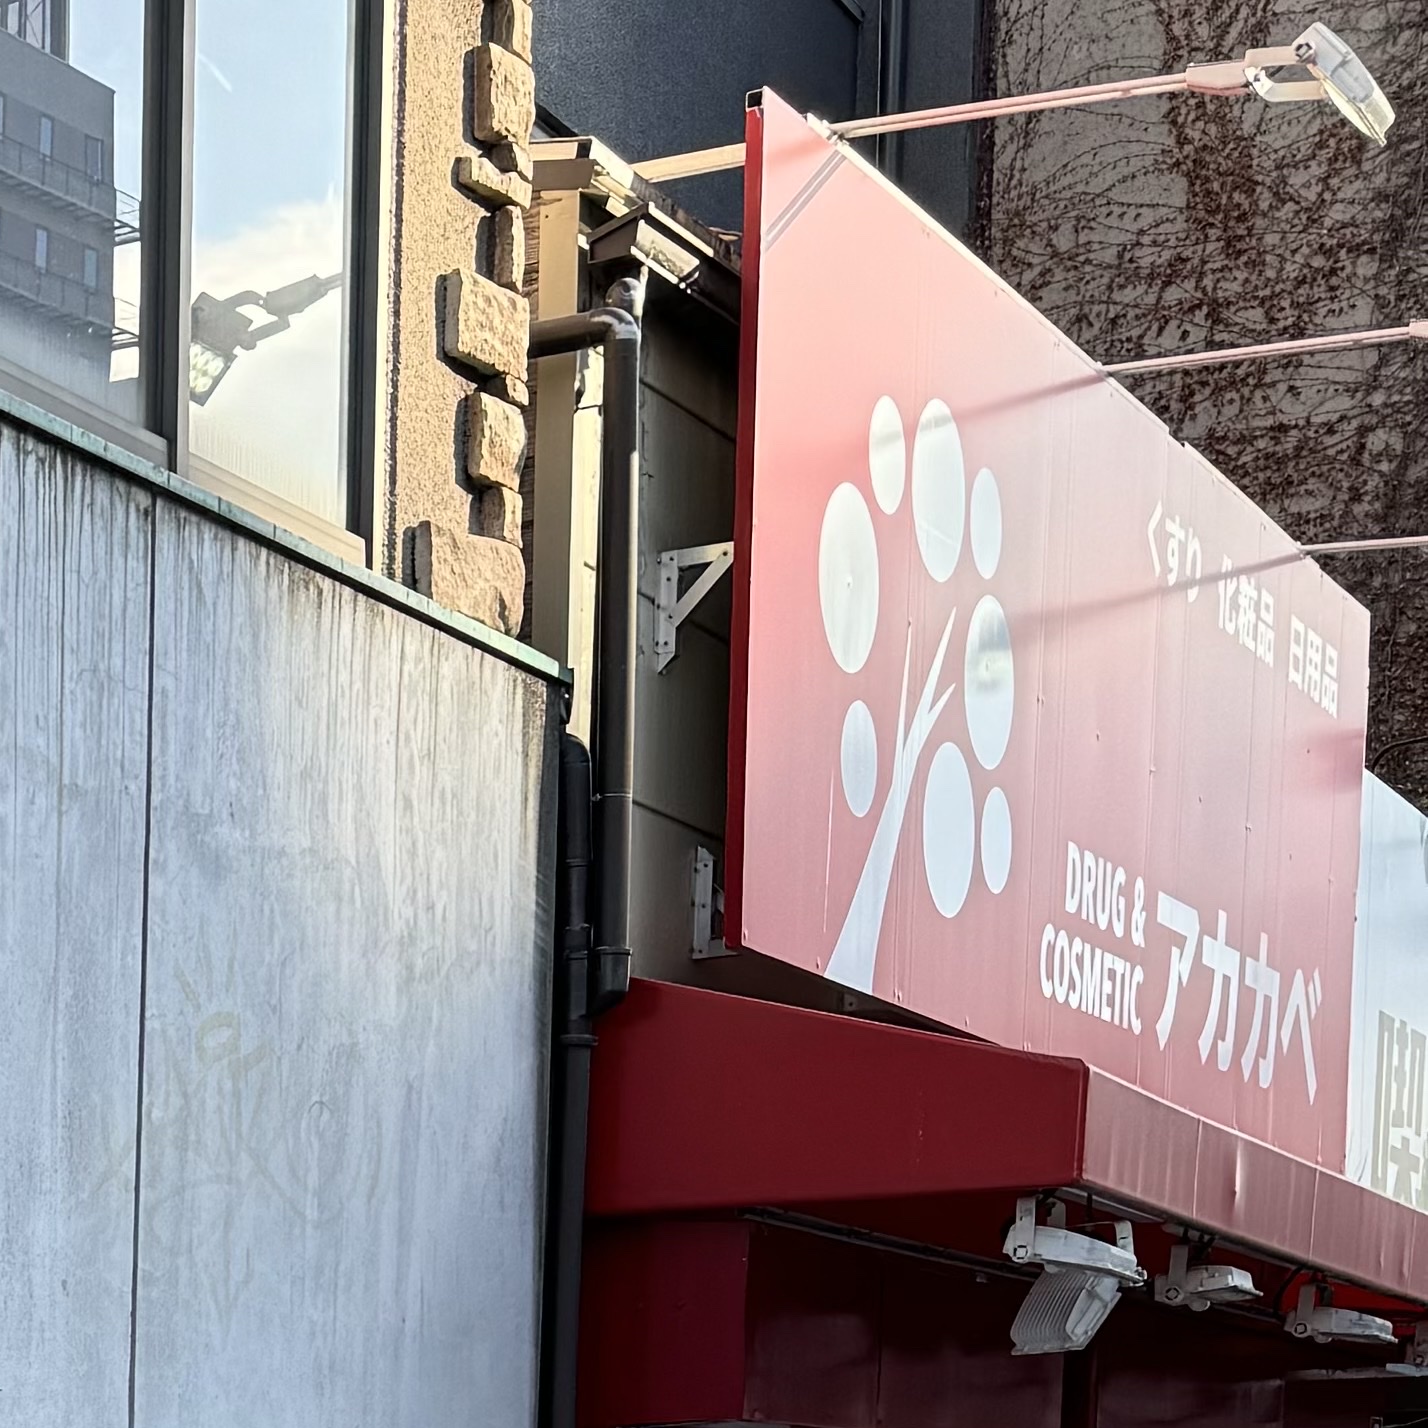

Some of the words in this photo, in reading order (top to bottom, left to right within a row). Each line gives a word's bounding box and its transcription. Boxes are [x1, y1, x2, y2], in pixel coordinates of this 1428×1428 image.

[1146, 498, 1203, 602] くすり
[1218, 554, 1275, 667] 化粧品
[1287, 614, 1340, 719] 日用品
[1065, 840, 1126, 939] DRUG
[1130, 875, 1146, 948] &
[1039, 922, 1143, 1036] COSMETIC
[1154, 890, 1322, 1106] アカカベ
